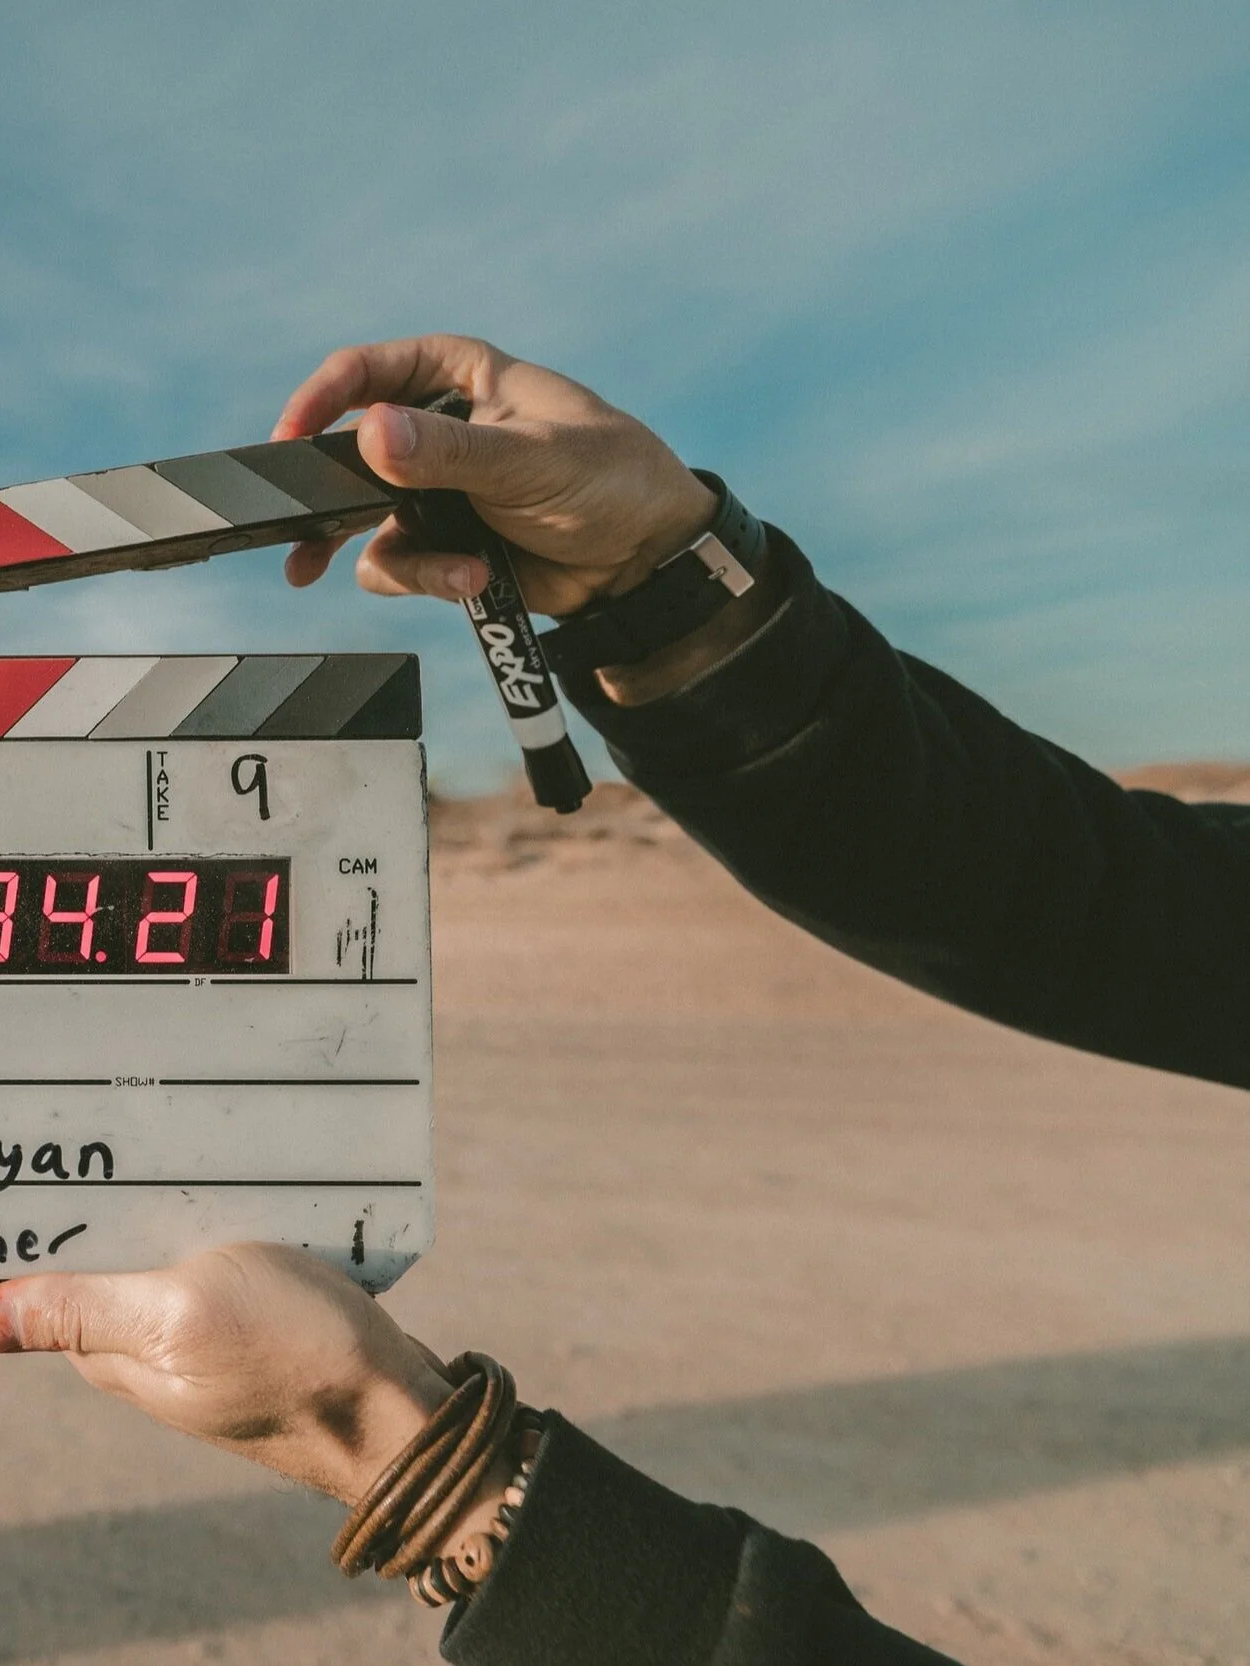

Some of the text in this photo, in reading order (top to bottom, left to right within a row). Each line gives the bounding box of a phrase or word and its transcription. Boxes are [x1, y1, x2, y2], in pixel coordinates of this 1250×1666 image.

[480, 623, 544, 708] EXPO
[516, 613, 541, 669] dry erase
[156, 751, 170, 821] TAKE
[230, 753, 271, 821] 9
[338, 857, 378, 875] CAM
[194, 977, 207, 987] DF
[115, 1076, 155, 1087] SHOW#
